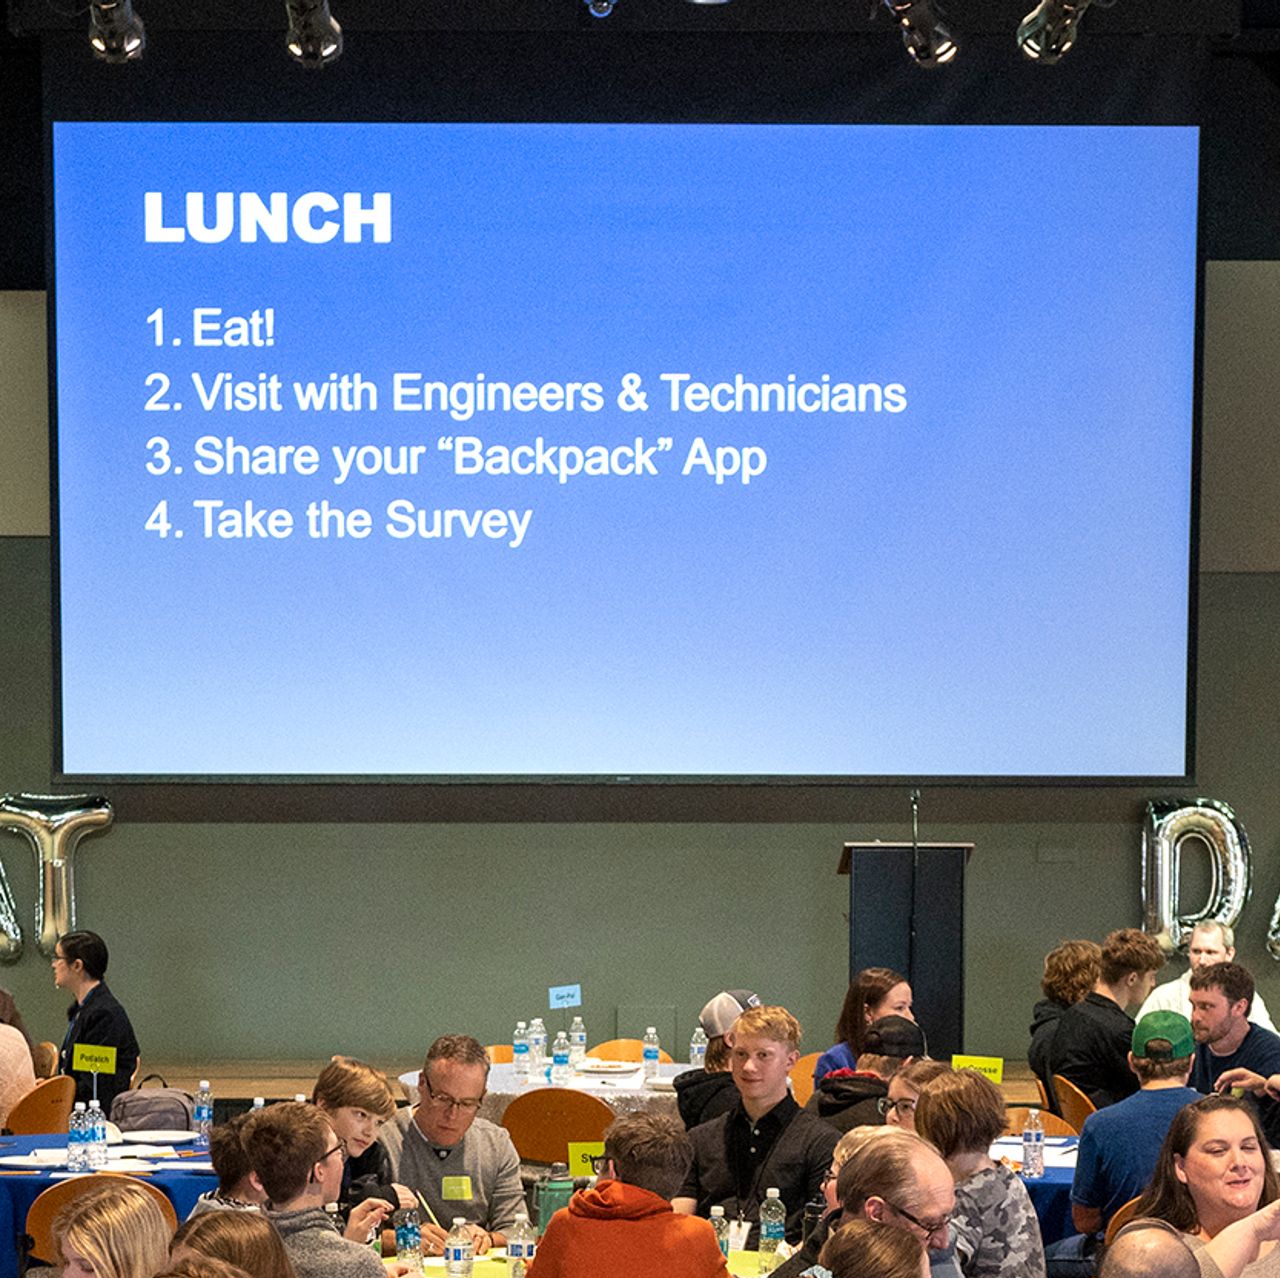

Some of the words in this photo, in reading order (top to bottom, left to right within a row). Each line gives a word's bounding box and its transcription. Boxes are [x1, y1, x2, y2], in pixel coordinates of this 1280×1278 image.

[145, 192, 391, 244] LUNCH
[147, 308, 181, 346] 1.
[193, 308, 275, 347] Eat!
[145, 372, 182, 411] 2.
[192, 372, 283, 411] Visit
[293, 373, 377, 411] with
[393, 373, 604, 421] Engineers
[617, 373, 649, 412] &
[660, 373, 907, 413] Technicians
[146, 436, 183, 475] 3.
[194, 436, 320, 475] Share
[332, 445, 427, 485] your
[683, 438, 767, 485] App
[145, 500, 184, 538] 4.
[193, 500, 294, 539] Take
[306, 501, 374, 539] the
[386, 500, 533, 548] Survey
